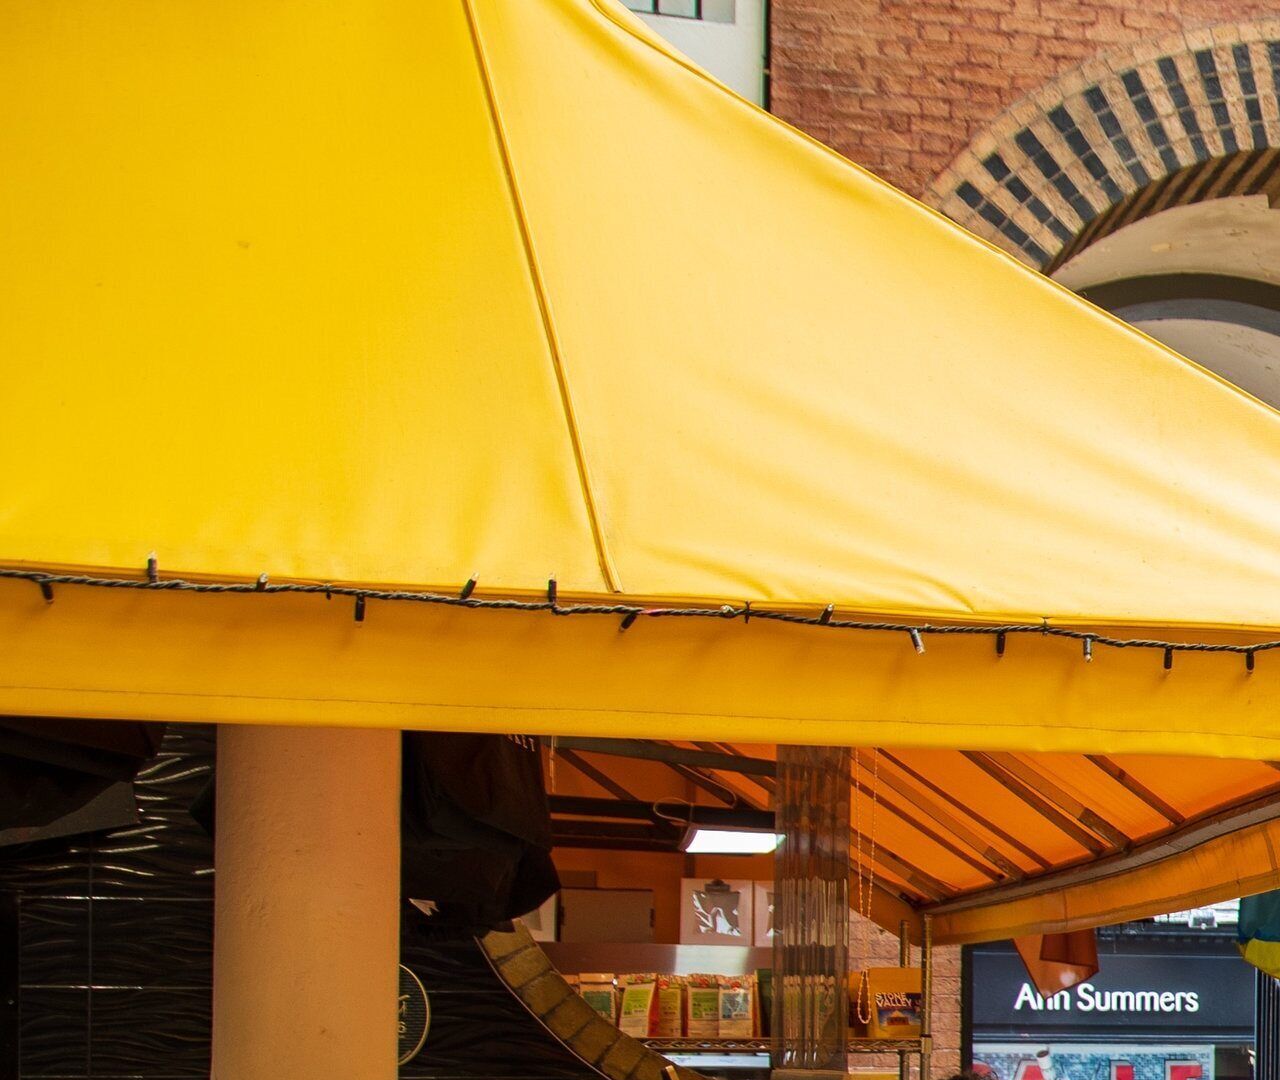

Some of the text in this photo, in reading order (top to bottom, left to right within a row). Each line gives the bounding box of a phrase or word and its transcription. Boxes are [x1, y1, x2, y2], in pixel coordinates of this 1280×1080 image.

[876, 992, 906, 1001] STONE
[1076, 983, 1200, 1013] Summers
[876, 999, 912, 1007] VALLEY
